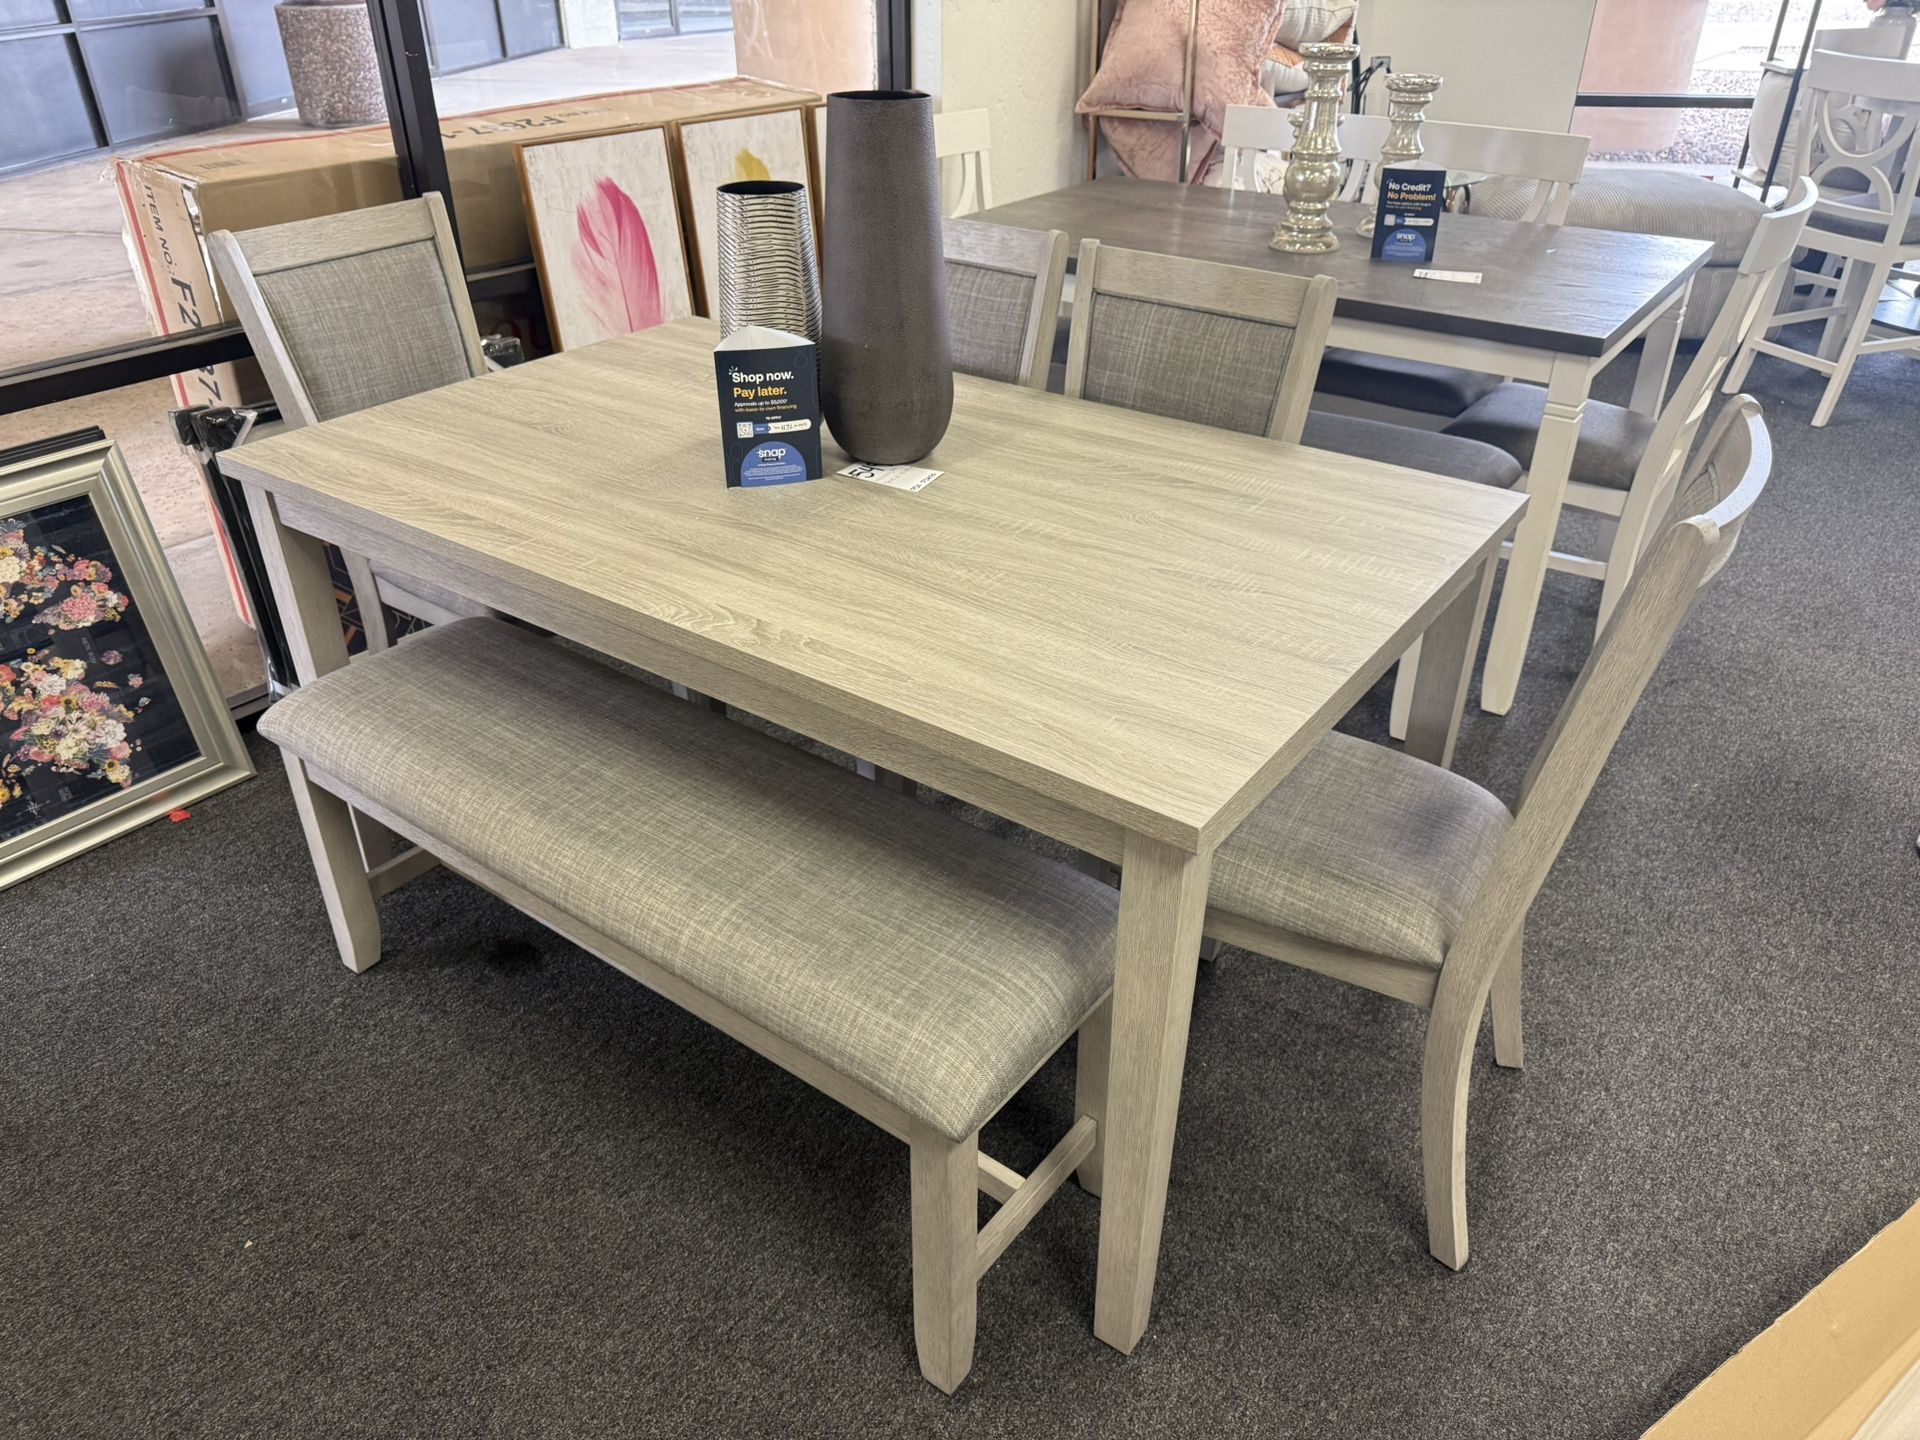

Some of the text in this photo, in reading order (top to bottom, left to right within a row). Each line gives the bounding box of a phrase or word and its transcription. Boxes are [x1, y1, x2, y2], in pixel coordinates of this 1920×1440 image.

[1389, 182, 1432, 192] No Credit?
[1387, 191, 1437, 201] No Problem!
[144, 184, 164, 233] ITEM
[1396, 232, 1416, 241] snap
[732, 371, 795, 385] Shop now.
[733, 386, 788, 400] Pay later.
[757, 447, 786, 460] snap
